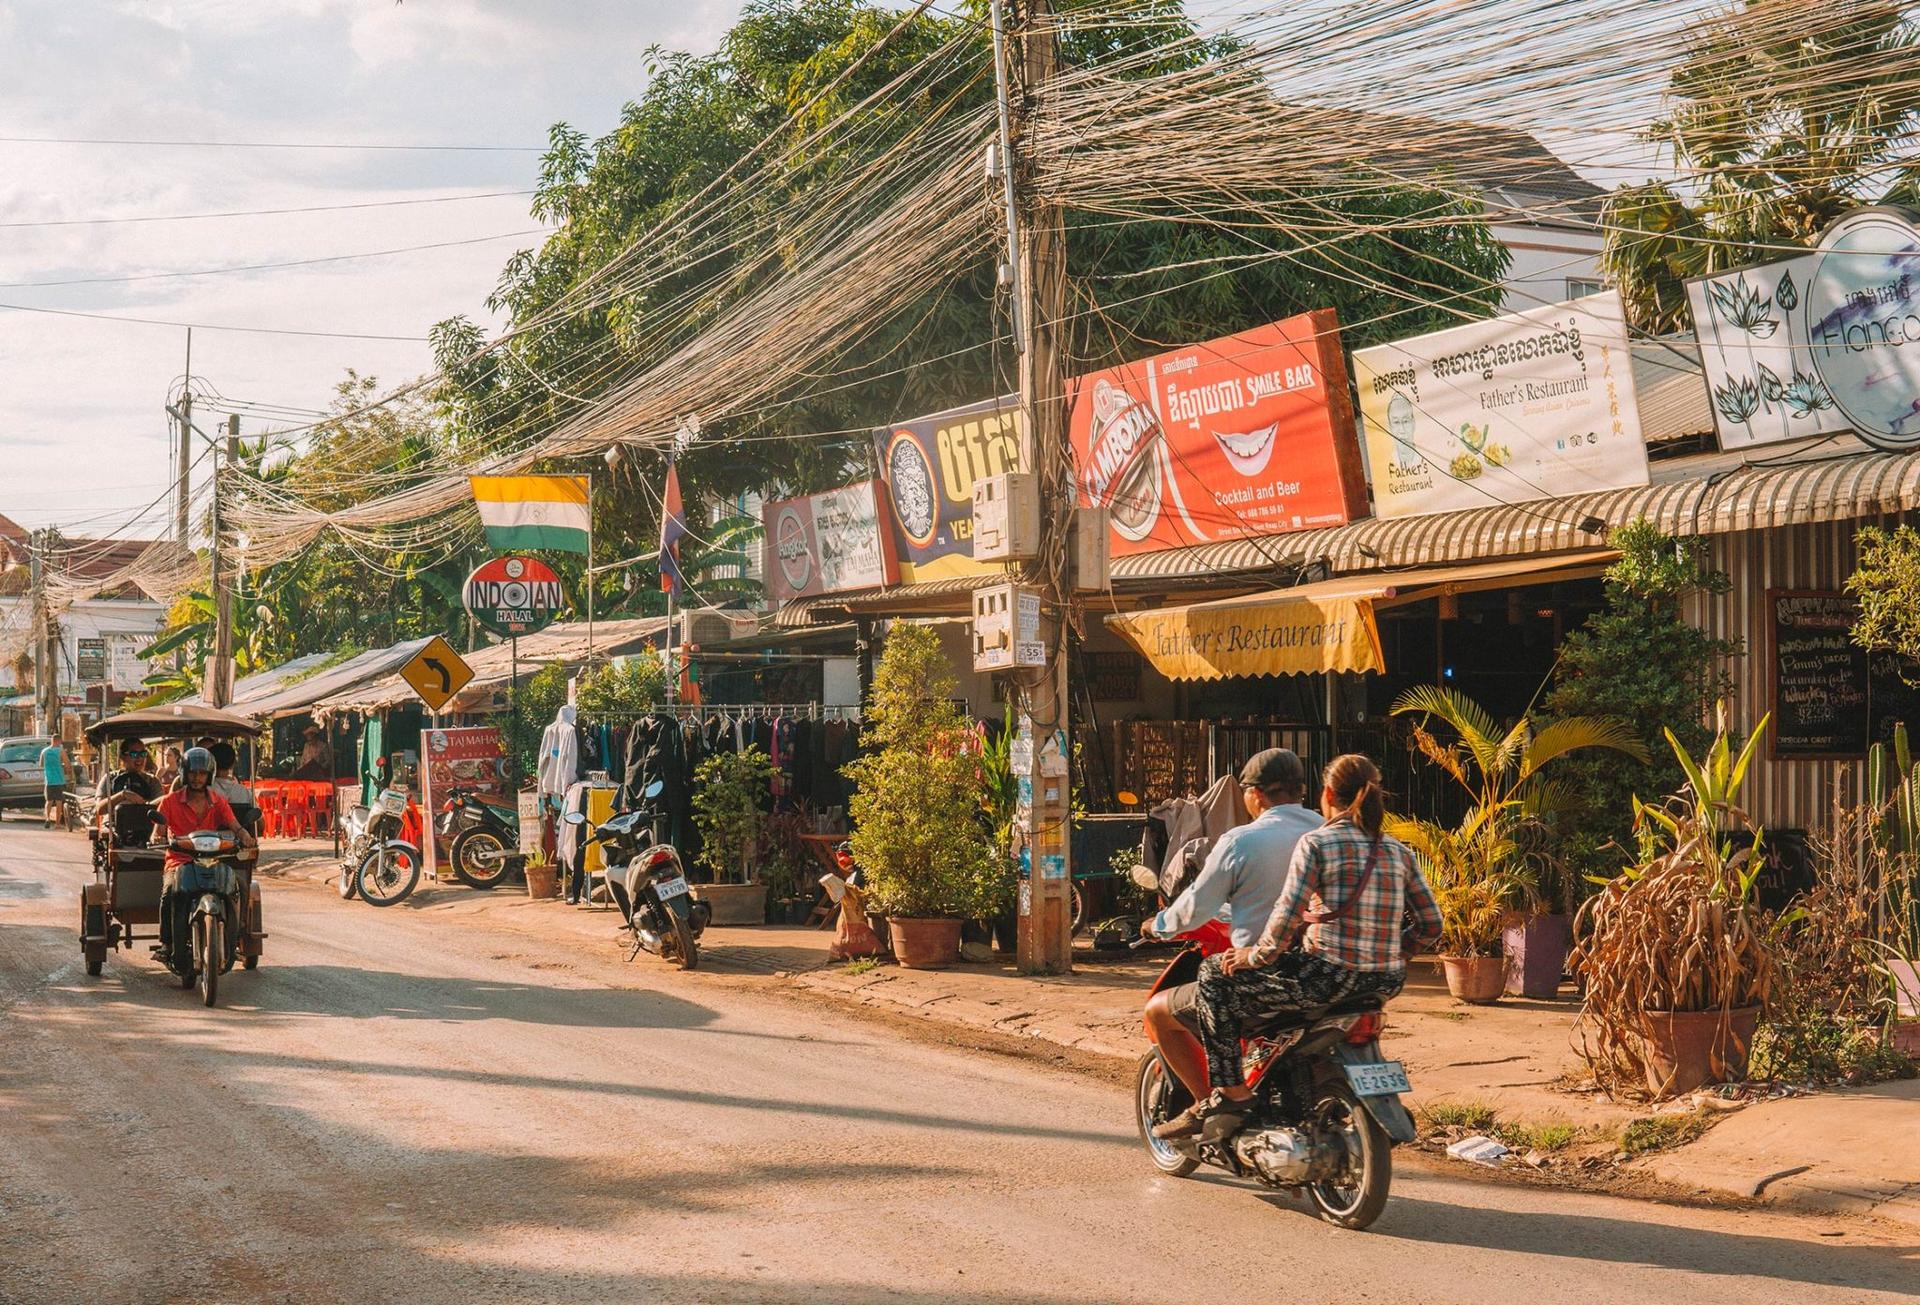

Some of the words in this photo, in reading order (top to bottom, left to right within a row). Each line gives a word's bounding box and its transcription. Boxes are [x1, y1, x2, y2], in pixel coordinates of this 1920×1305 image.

[1246, 369, 1283, 406] SMILE
[1286, 364, 1315, 388] BAR
[1480, 385, 1524, 409] Father's
[1526, 374, 1589, 400] Restaurant
[1388, 457, 1429, 478] Father's
[1215, 486, 1254, 506] Cocktail
[1256, 484, 1275, 500] and
[1276, 481, 1301, 497] Beer
[1388, 477, 1433, 495] Restaurant
[496, 610, 533, 622] HALAL
[1153, 621, 1223, 656] Father's
[1227, 617, 1347, 653] Restaurant
